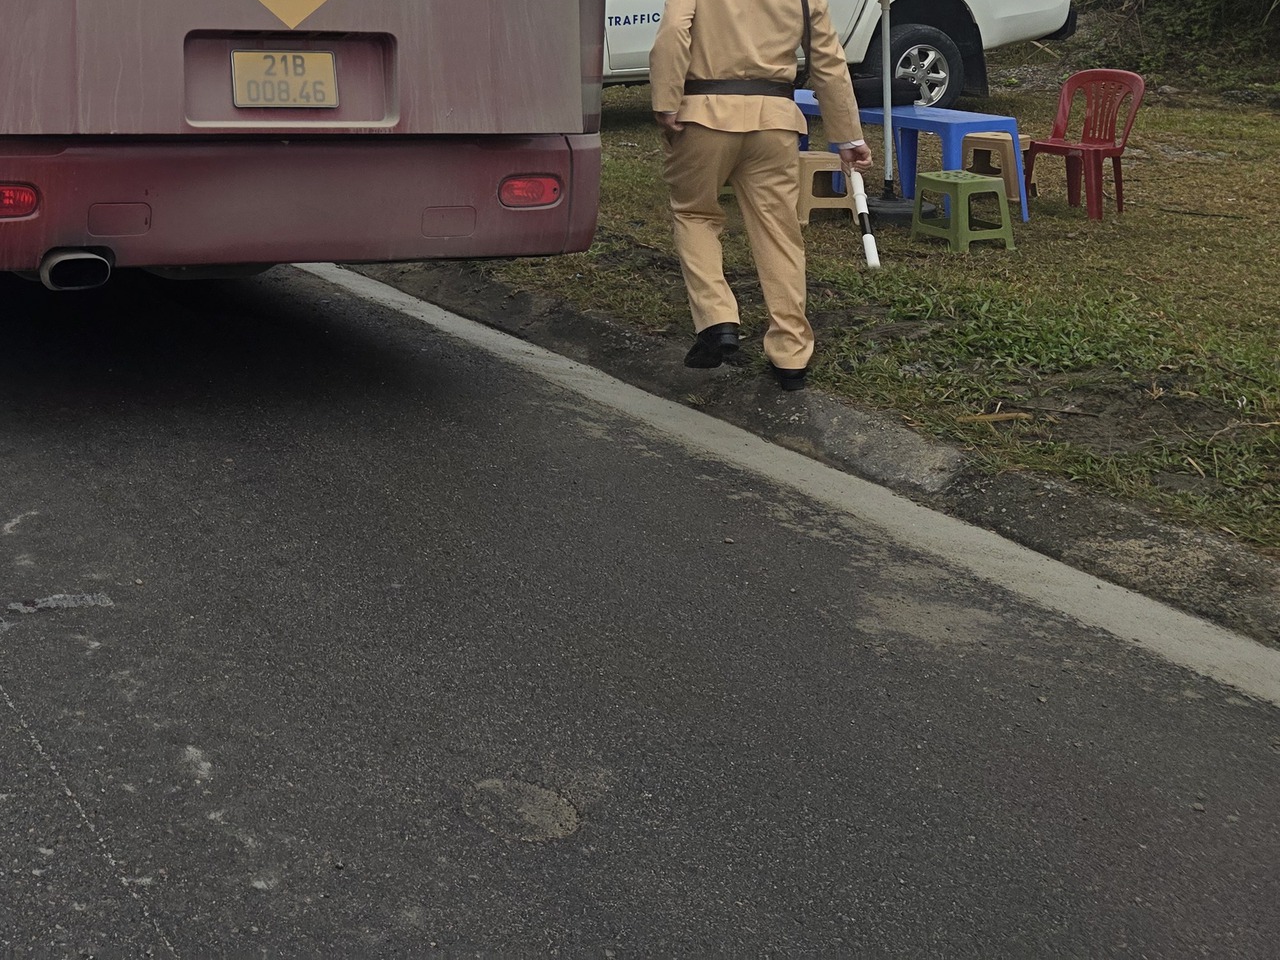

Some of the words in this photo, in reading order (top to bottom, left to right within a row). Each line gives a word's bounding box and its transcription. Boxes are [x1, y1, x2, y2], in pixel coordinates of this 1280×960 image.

[608, 12, 661, 27] TRAFFIC
[262, 54, 306, 77] 21B
[246, 79, 326, 103] 008.46
